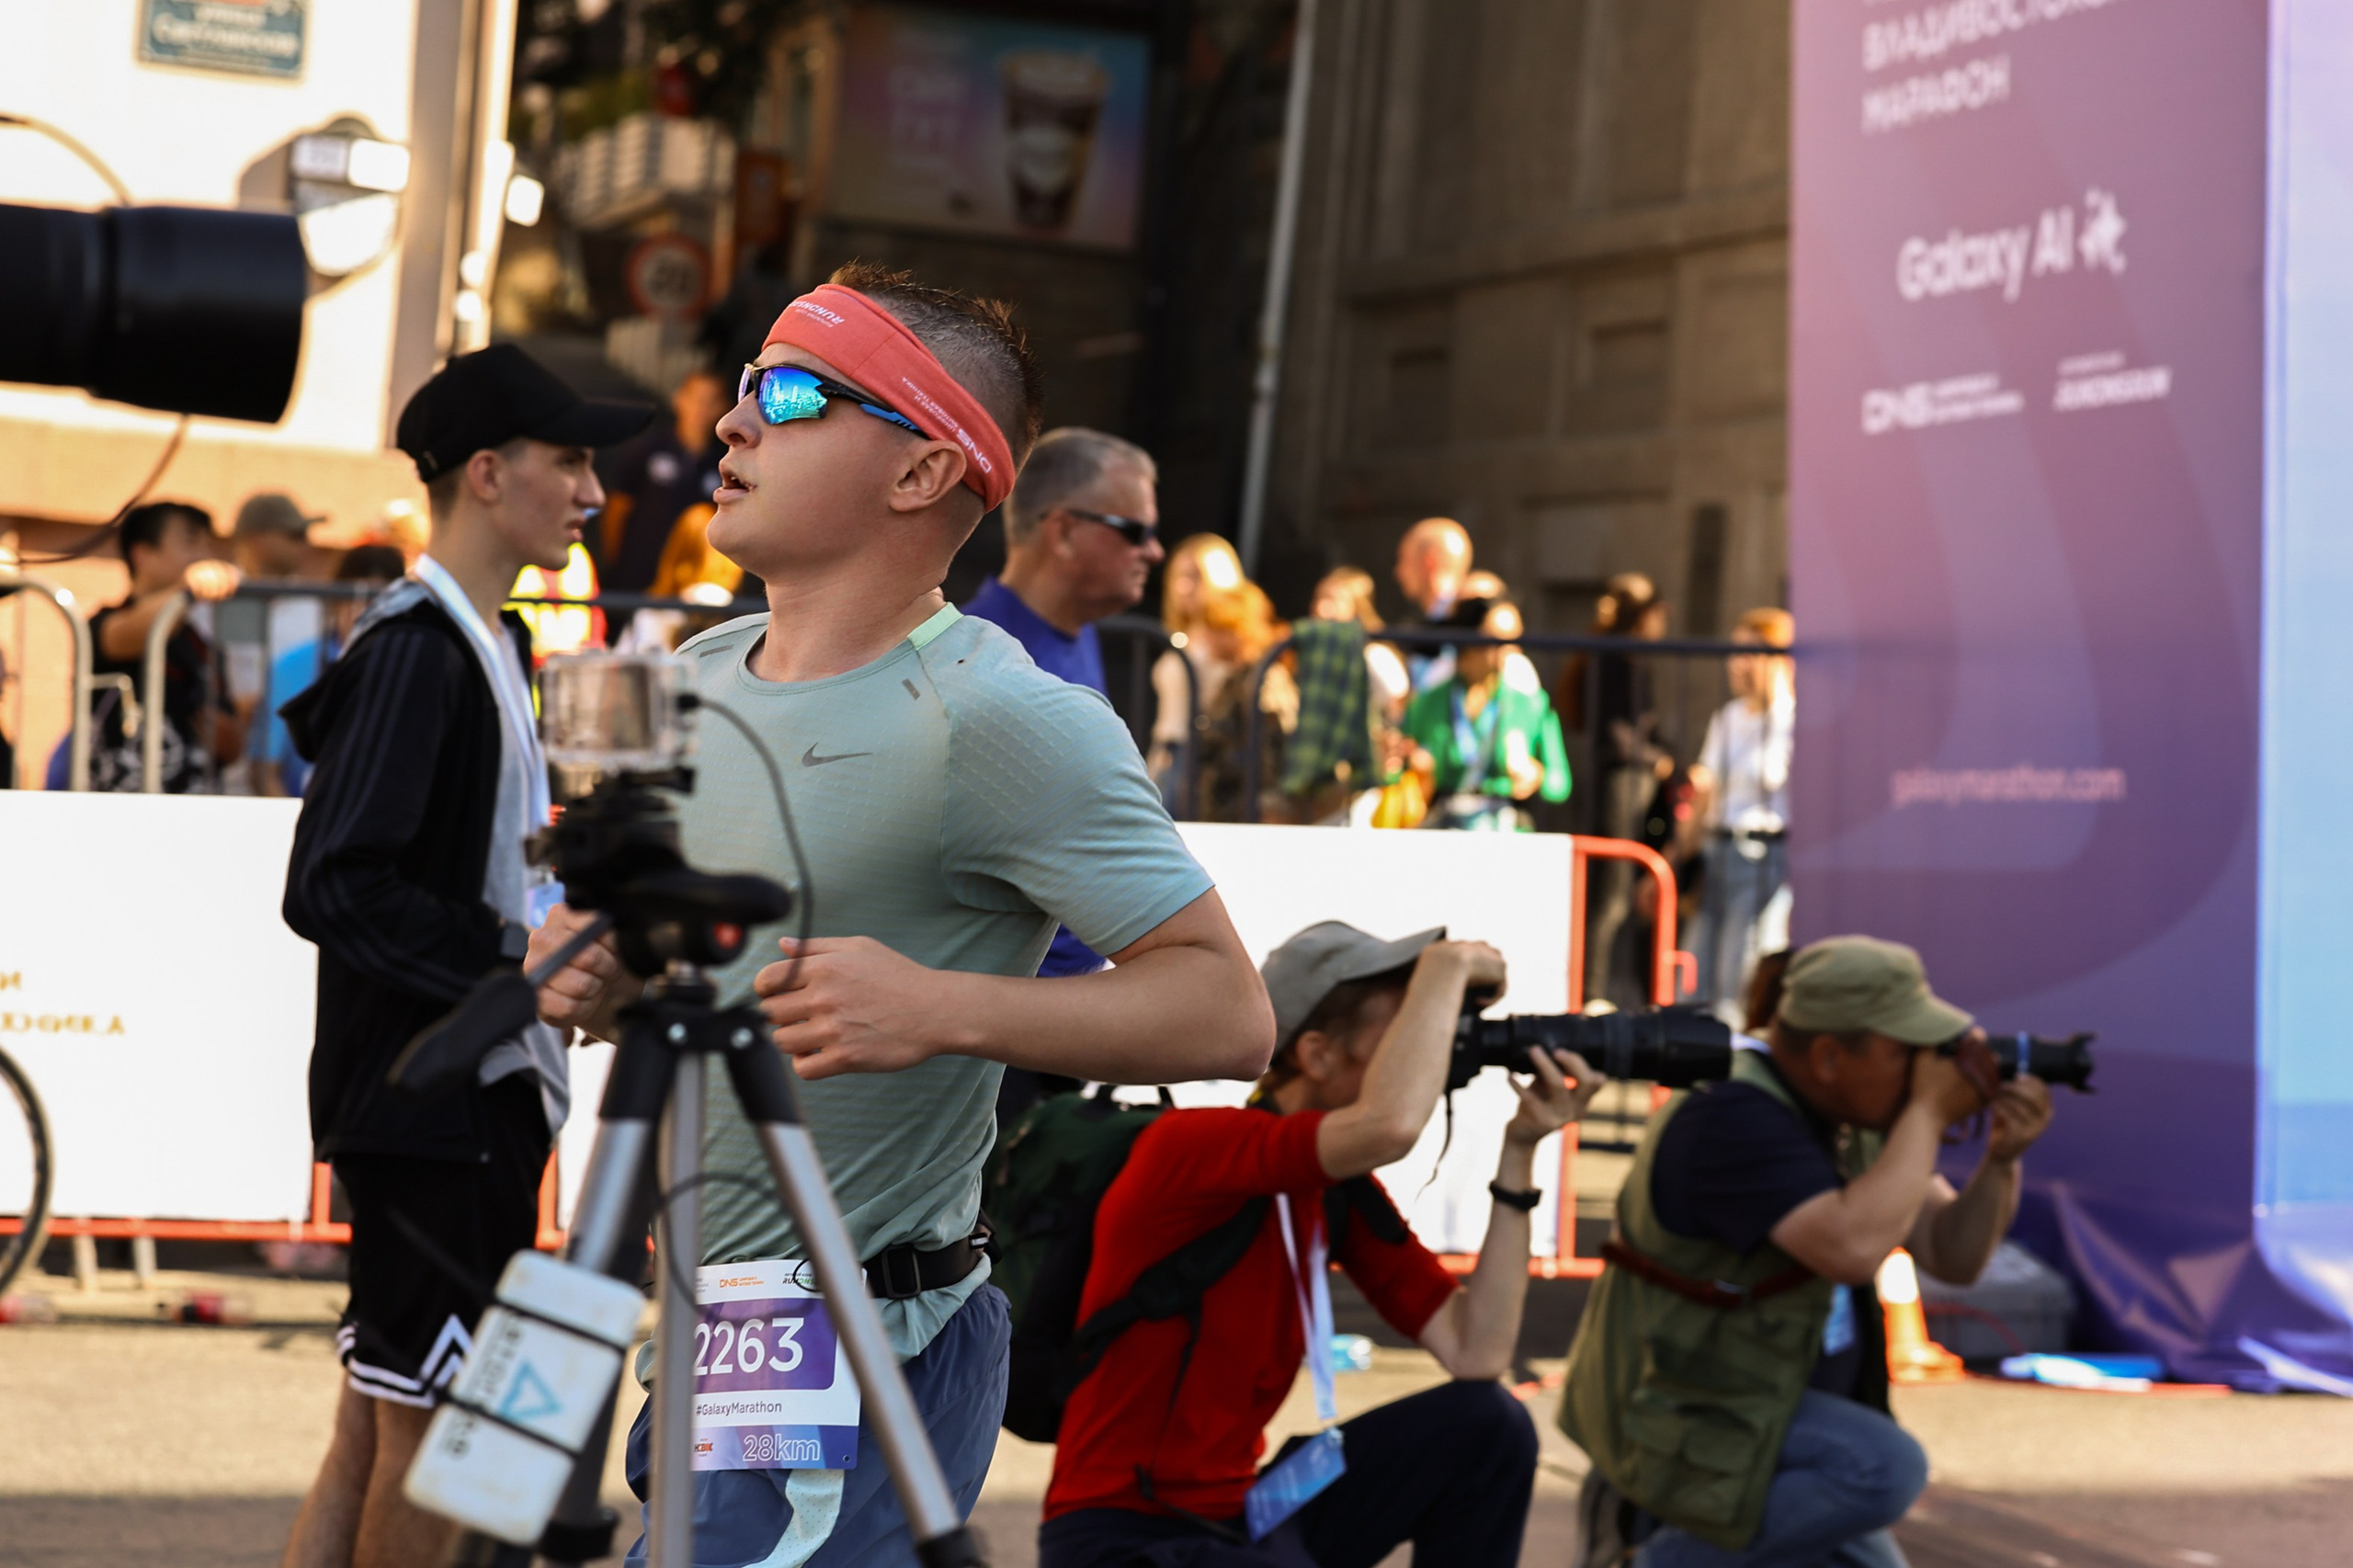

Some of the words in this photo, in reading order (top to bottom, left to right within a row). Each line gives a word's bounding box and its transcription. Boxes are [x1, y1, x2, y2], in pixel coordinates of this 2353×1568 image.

[1896, 228, 2030, 302] Galaxy
[2032, 205, 2075, 276] AI
[957, 428, 992, 473] DNS
[720, 1278, 738, 1288] DNS
[693, 1317, 804, 1376] 2263
[696, 1401, 782, 1416] #GalaxyMarathon
[743, 1433, 821, 1461] 28km
